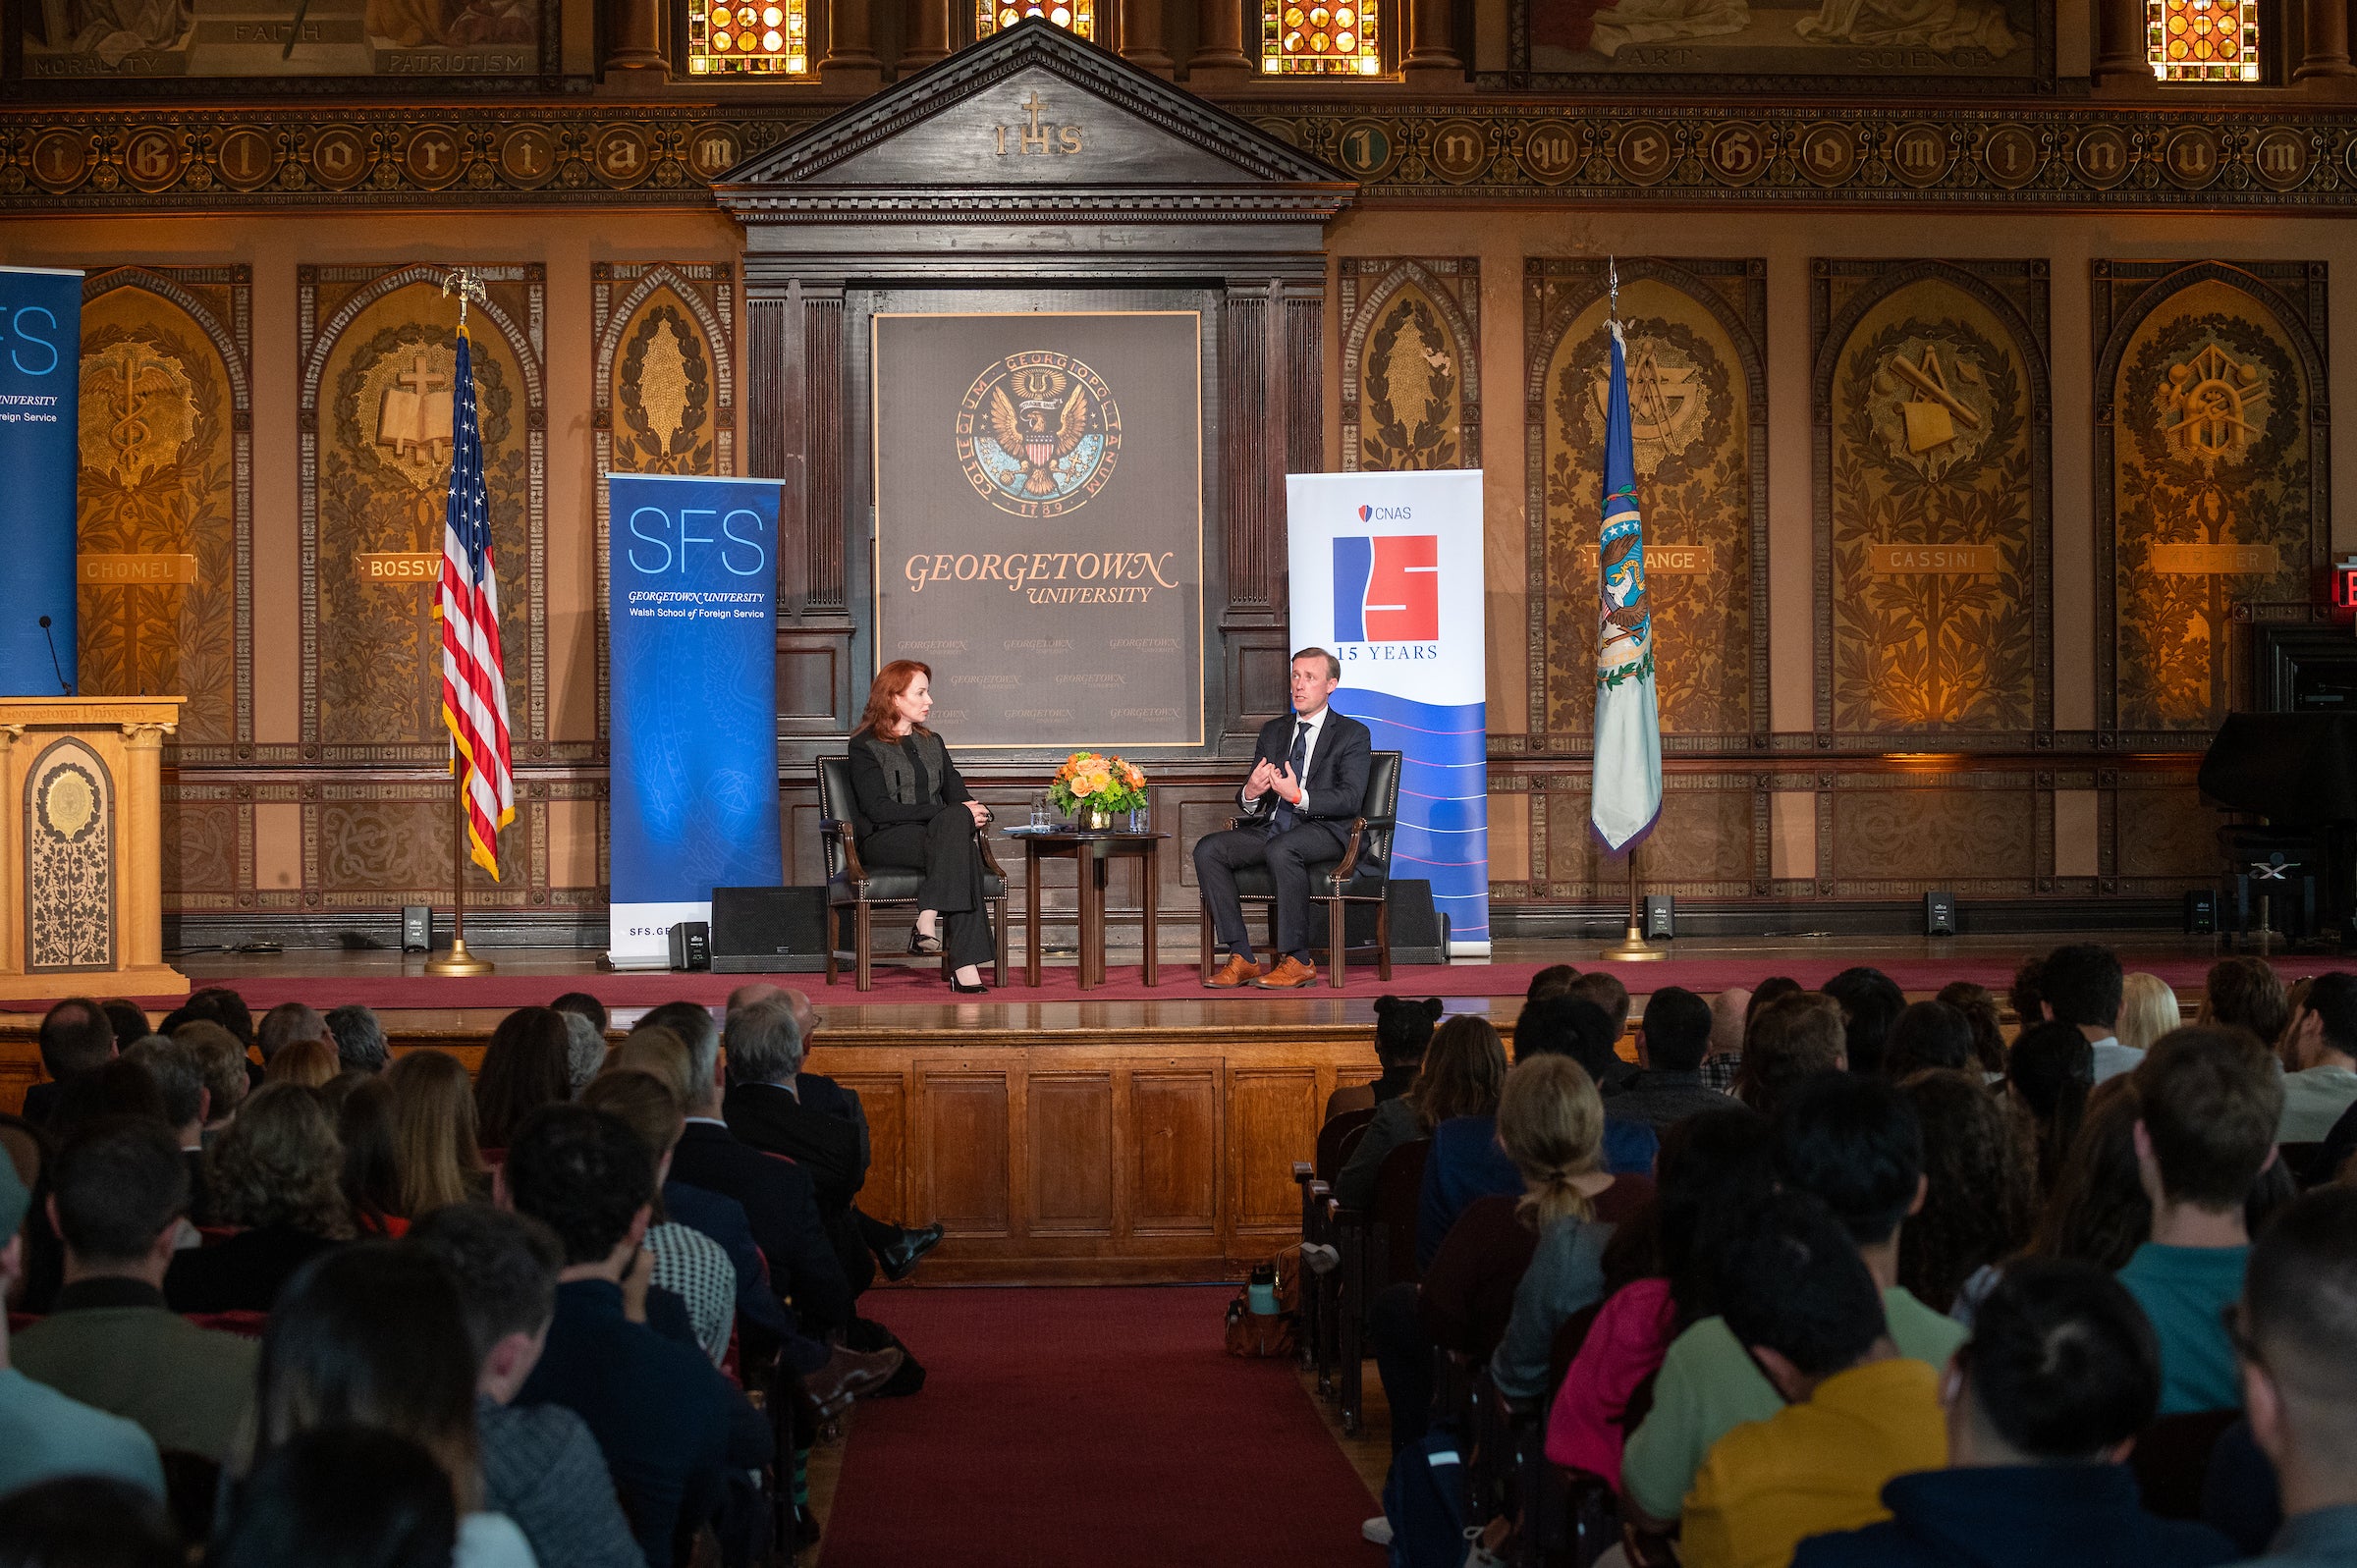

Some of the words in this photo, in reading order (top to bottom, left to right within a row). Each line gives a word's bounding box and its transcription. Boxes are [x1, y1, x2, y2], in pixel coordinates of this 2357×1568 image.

[388, 54, 525, 73] PATRIOTISM
[1626, 48, 1693, 67] ART
[1855, 50, 1990, 69] SCIENCE
[994, 126, 1083, 155] IHS
[0, 395, 58, 406] NIVERSITY
[0, 412, 21, 423] reign
[24, 412, 57, 422] Service
[959, 380, 993, 495] COLLEGIUM
[1006, 353, 1119, 494] GEORGIOPOLITANUM
[1020, 503, 1063, 515] 1789
[1375, 507, 1411, 520] CNAS
[628, 506, 765, 576] SFS
[1592, 553, 1695, 568] LANGE
[1890, 551, 1976, 568] CASSINI
[86, 562, 174, 578] CHOMEL
[370, 560, 442, 576] BOSSV
[904, 552, 1178, 593] GEORGETOWN
[629, 591, 703, 605] GEORGETOWN
[703, 592, 765, 603] UNIVERSITY
[1026, 587, 1153, 604] UNIVERSITY
[630, 608, 655, 617] Walsh
[657, 608, 685, 618] School
[687, 609, 697, 620] of
[698, 609, 731, 620] Foreign
[734, 610, 765, 619] Service
[1337, 646, 1358, 661] 15
[1368, 645, 1437, 660] YEARS
[0, 705, 79, 722] Georgetown
[82, 704, 148, 721] University
[927, 709, 968, 721] ETOWN
[630, 927, 671, 936] SFS.GE
